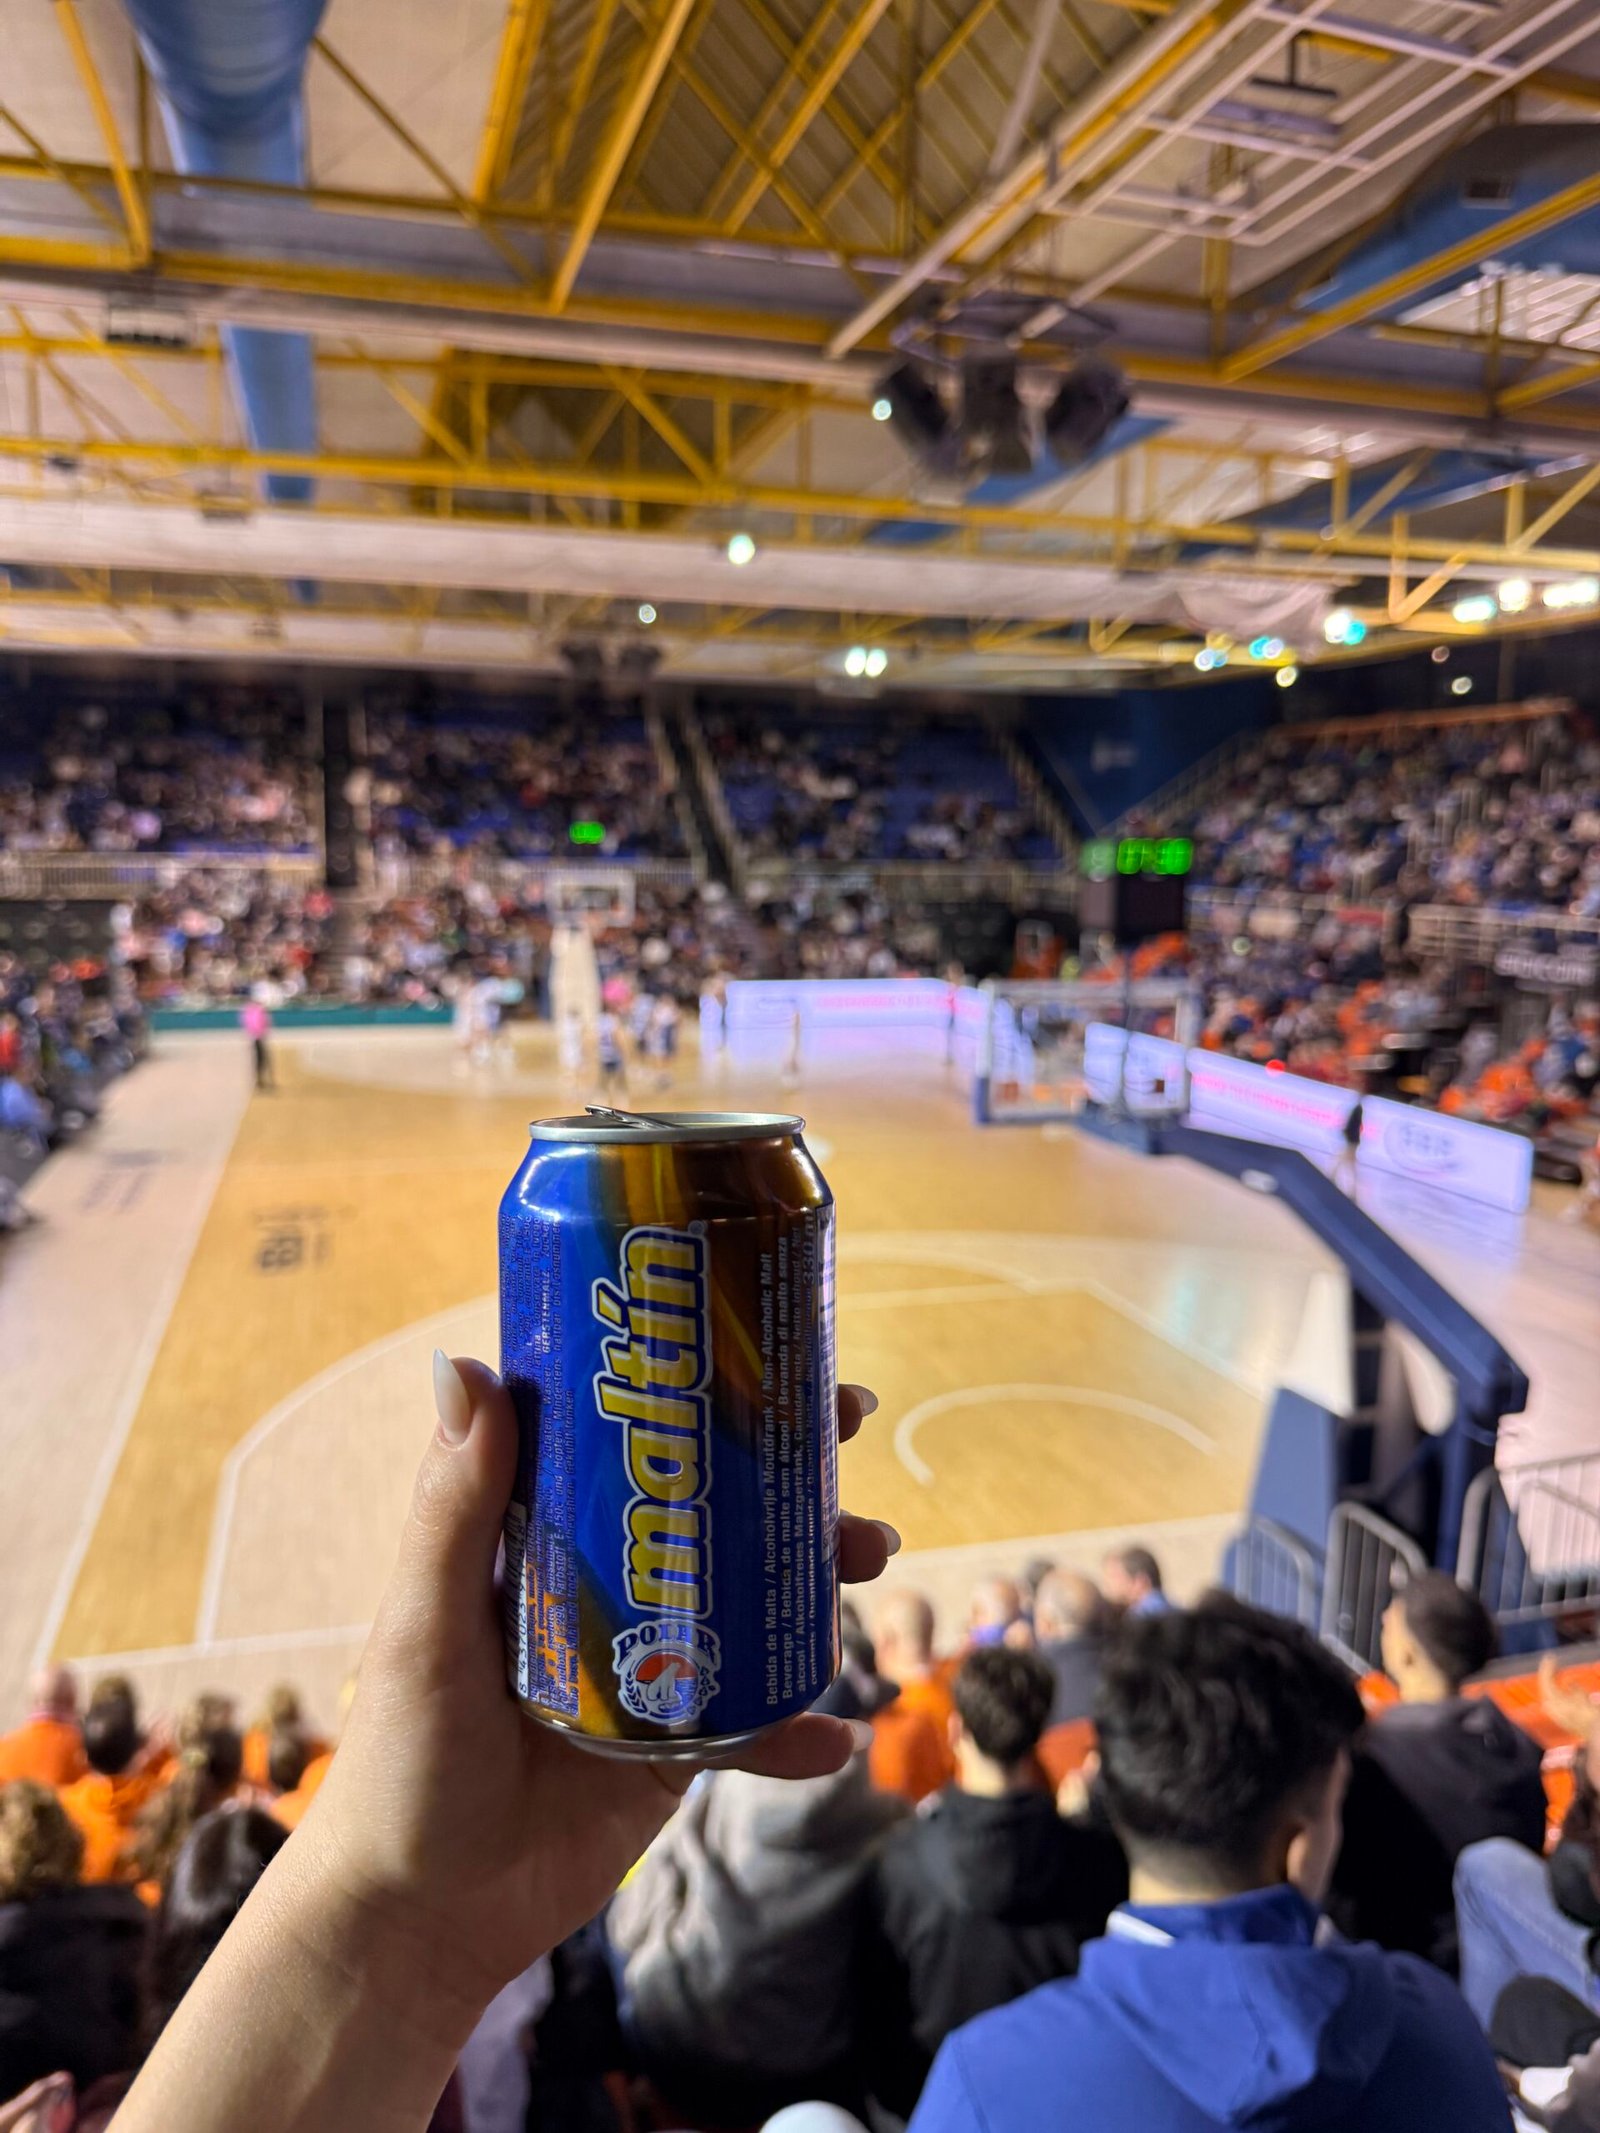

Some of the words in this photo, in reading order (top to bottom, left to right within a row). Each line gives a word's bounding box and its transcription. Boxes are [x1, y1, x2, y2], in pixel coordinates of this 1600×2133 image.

[760, 1252, 773, 1285] Malt
[778, 1236, 788, 1278] senza
[801, 1241, 816, 1285] 330
[776, 1281, 789, 1322] malto
[791, 1260, 802, 1304] inhoud
[552, 1312, 562, 1352] haltbar
[759, 1289, 774, 1390] Non-Alcoholic
[776, 1326, 789, 1340] di
[791, 1306, 802, 1340] Netto
[552, 1357, 563, 1420] Mindestens
[776, 1344, 790, 1406] Bevanda
[793, 1352, 803, 1381] neta
[594, 1226, 713, 1618] maltín
[793, 1384, 804, 1441] Cantidad
[761, 1405, 776, 1484] Moutdrank
[777, 1420, 791, 1463] álcool
[553, 1475, 563, 1495] und
[781, 1467, 790, 1498] sem
[793, 1444, 806, 1538] Malzgetränk.
[554, 1500, 564, 1540] E-150c
[763, 1487, 778, 1574] Alcoholvrije
[779, 1500, 791, 1542] malte
[554, 1545, 566, 1596] Farbstoff
[780, 1546, 791, 1564] de
[780, 1568, 792, 1618] Bebida
[794, 1540, 806, 1635] Alkoholfreies
[807, 1547, 817, 1619] Quantidade
[764, 1588, 777, 1630] Malta
[766, 1633, 778, 1651] de
[809, 1630, 818, 1686] contents
[766, 1655, 779, 1706] Bebida
[781, 1632, 795, 1700] Beverage
[796, 1648, 807, 1693] alcool
